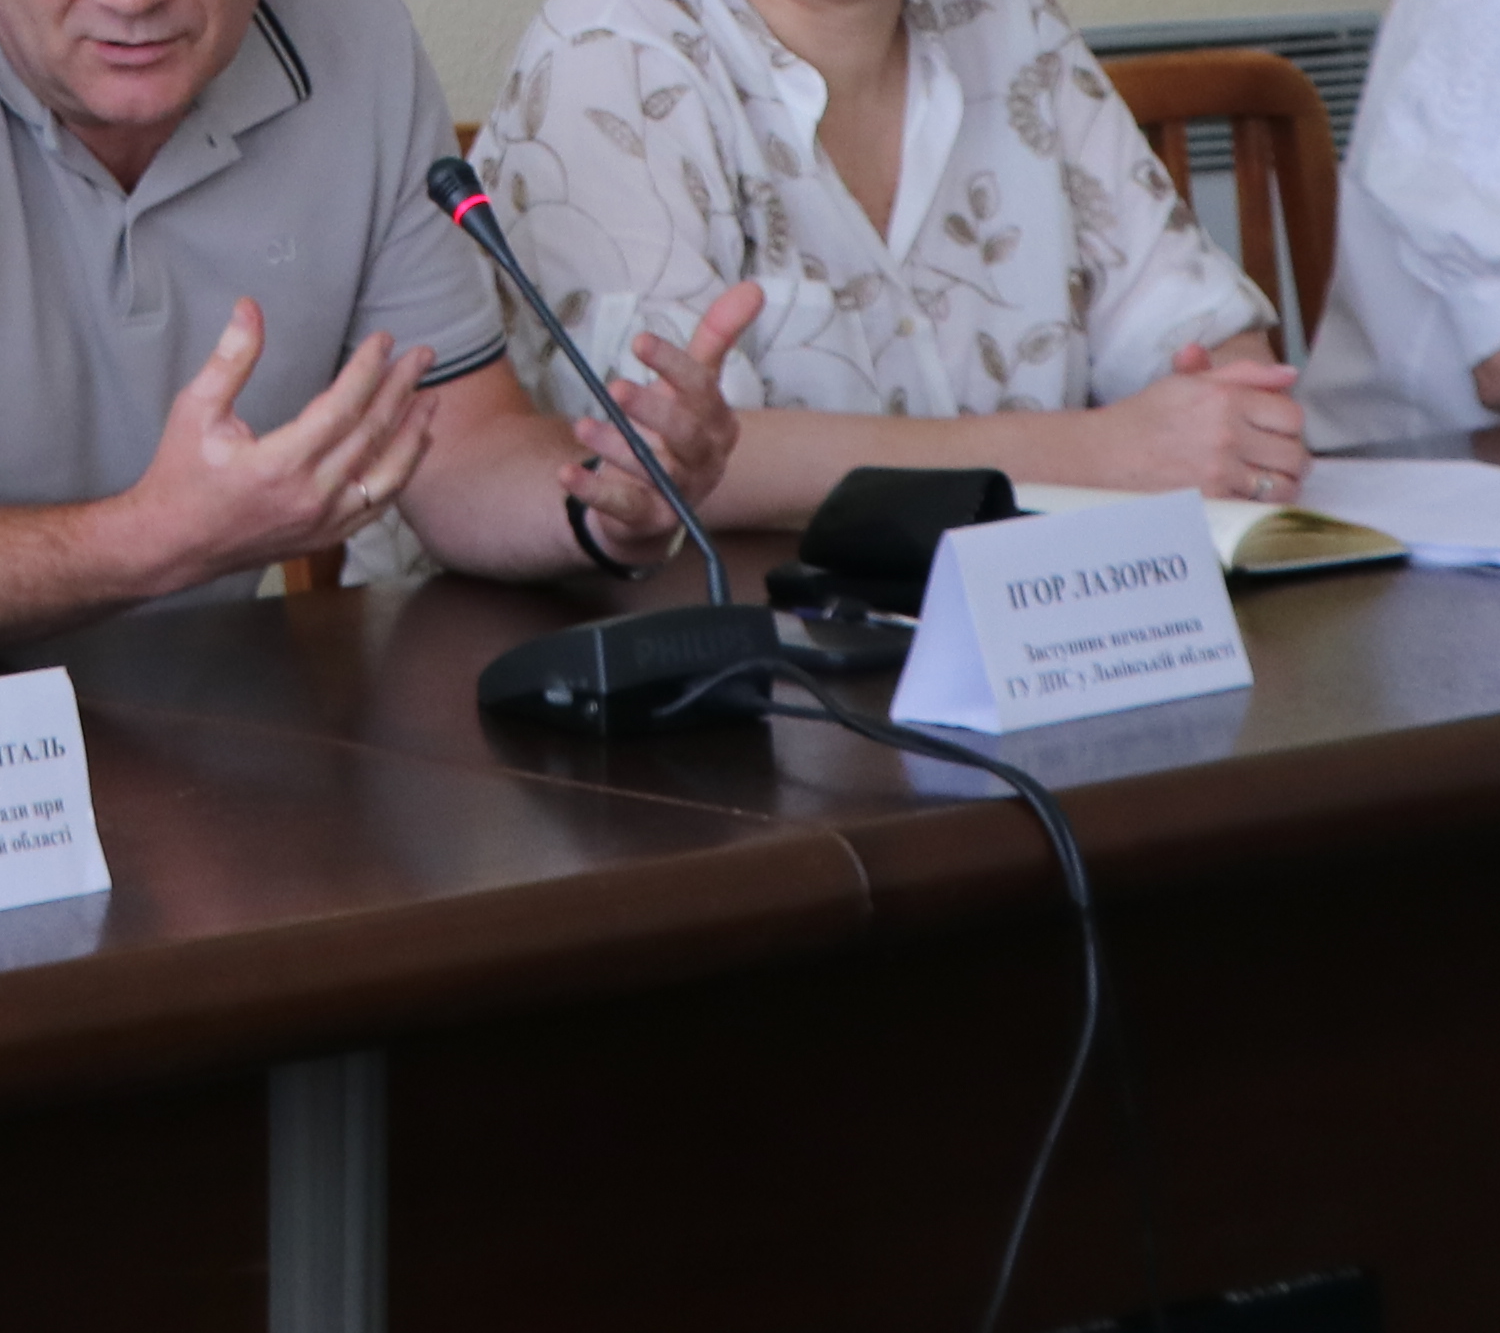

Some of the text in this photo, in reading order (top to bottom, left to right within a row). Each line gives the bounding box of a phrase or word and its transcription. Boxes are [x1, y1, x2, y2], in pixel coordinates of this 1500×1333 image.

[1007, 554, 1188, 609] ІГОР ЛАЗОРКО
[633, 623, 753, 669] PHILIPS
[32, 797, 64, 822] при
[12, 823, 73, 851] області
